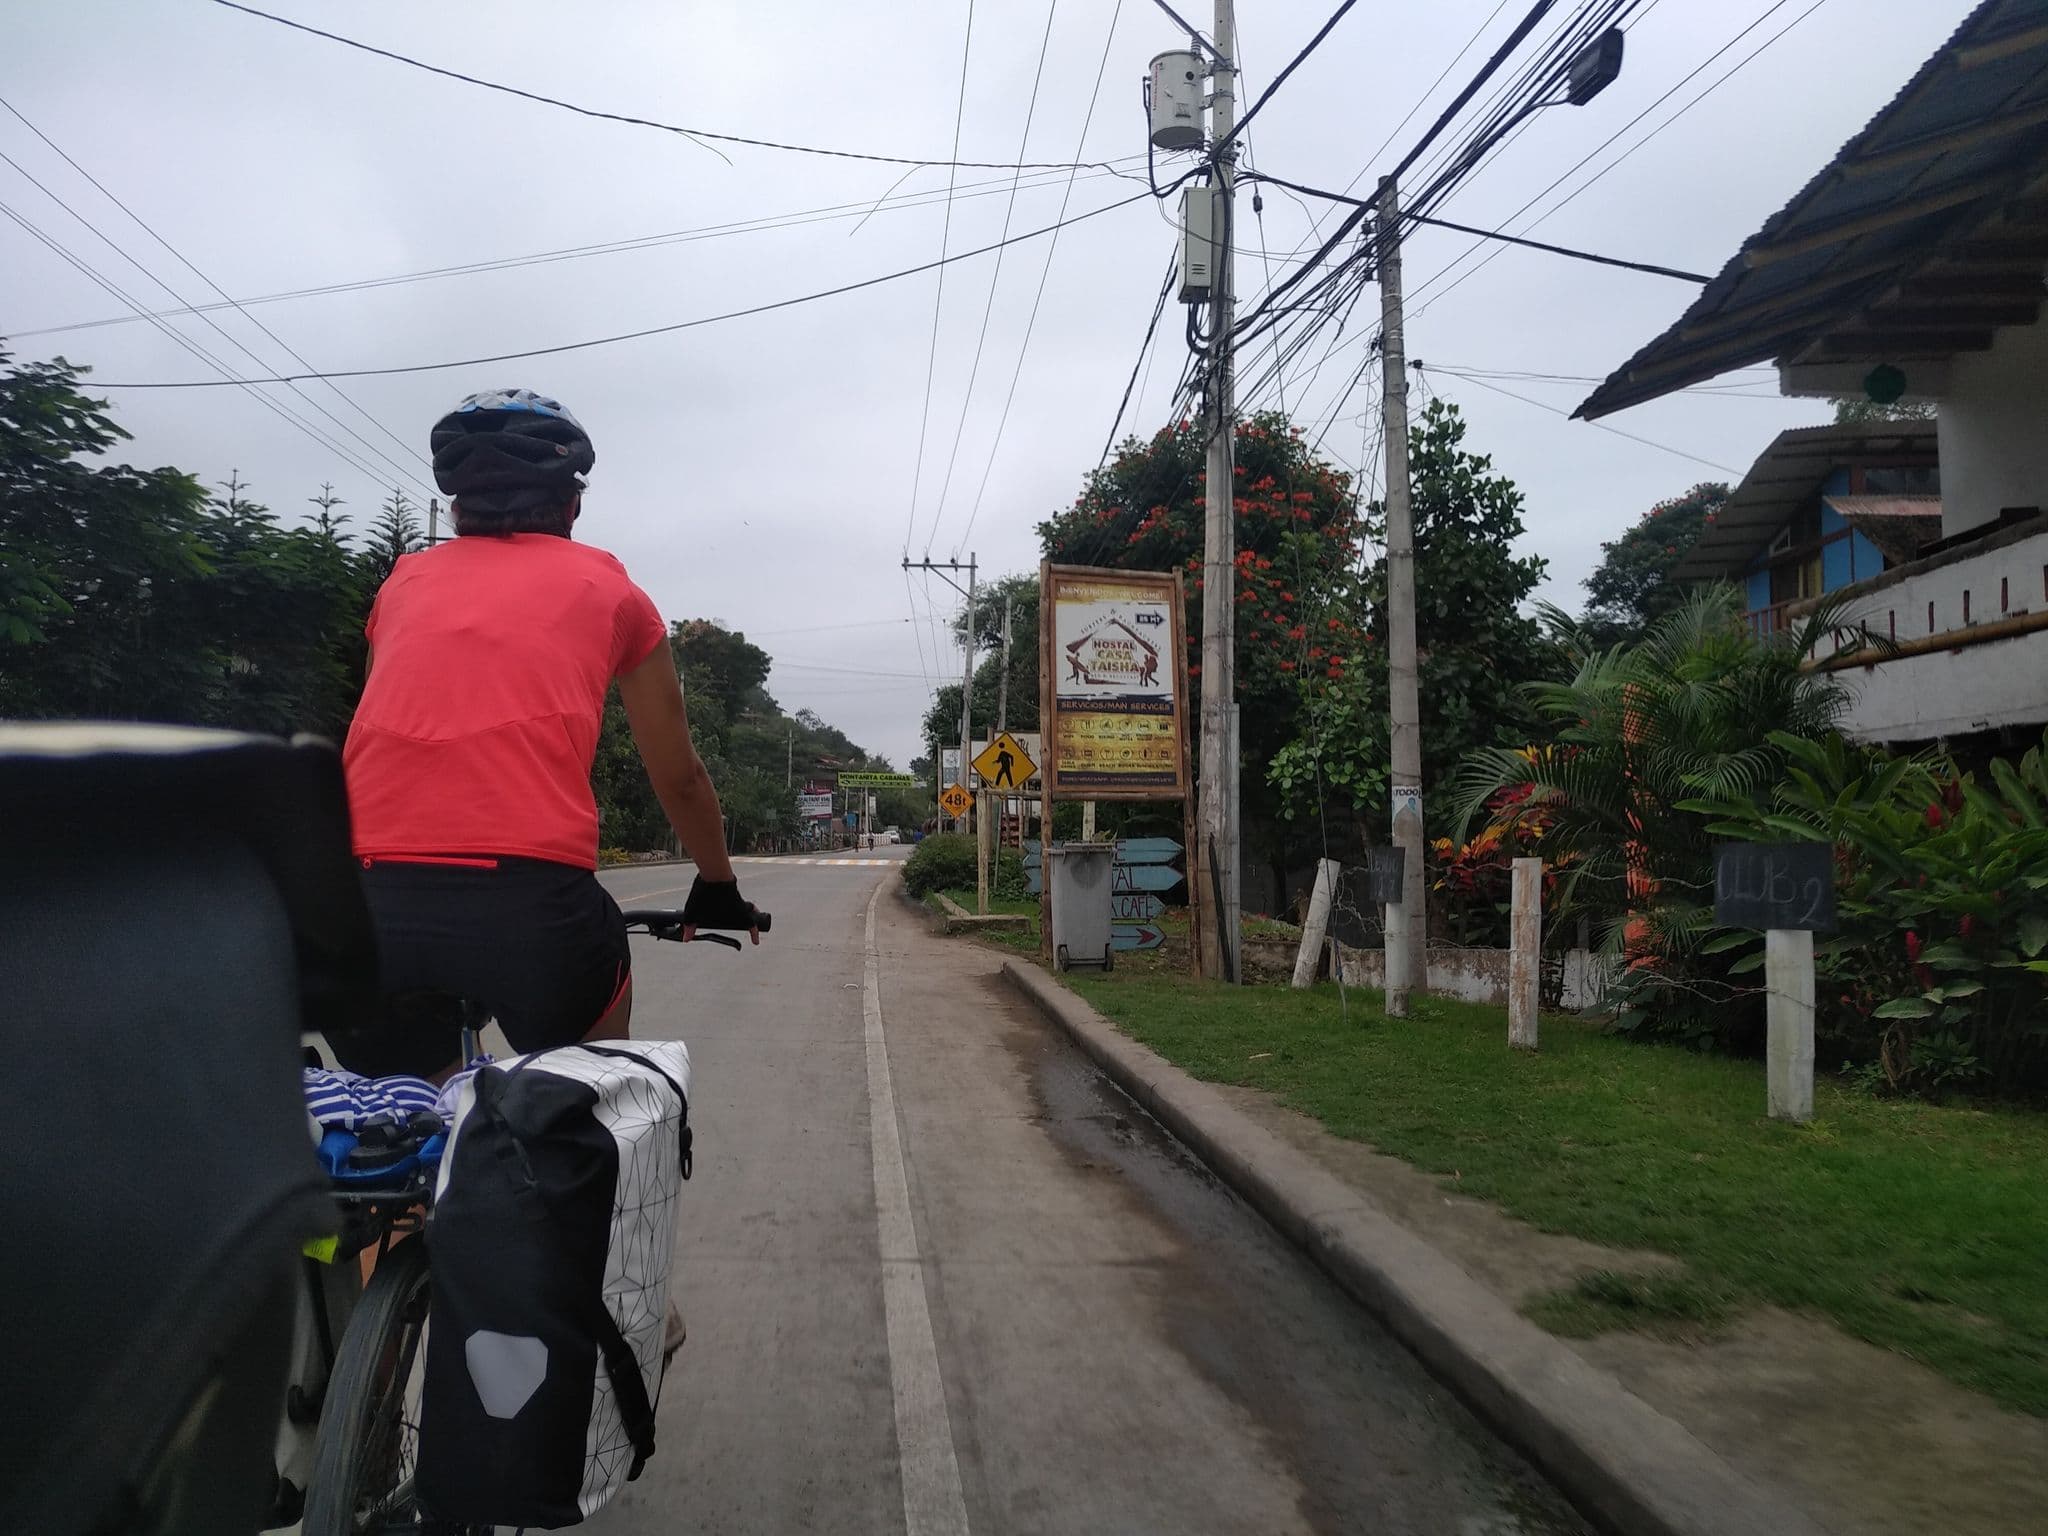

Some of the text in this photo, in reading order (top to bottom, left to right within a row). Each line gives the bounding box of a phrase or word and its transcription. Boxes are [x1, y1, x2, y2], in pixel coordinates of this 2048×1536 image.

[1093, 640, 1135, 650] HOSTAL
[1097, 649, 1132, 660] CASA
[1091, 660, 1140, 672] TAISHA
[1131, 702, 1170, 711] SERVICES
[945, 794, 967, 806] 48t
